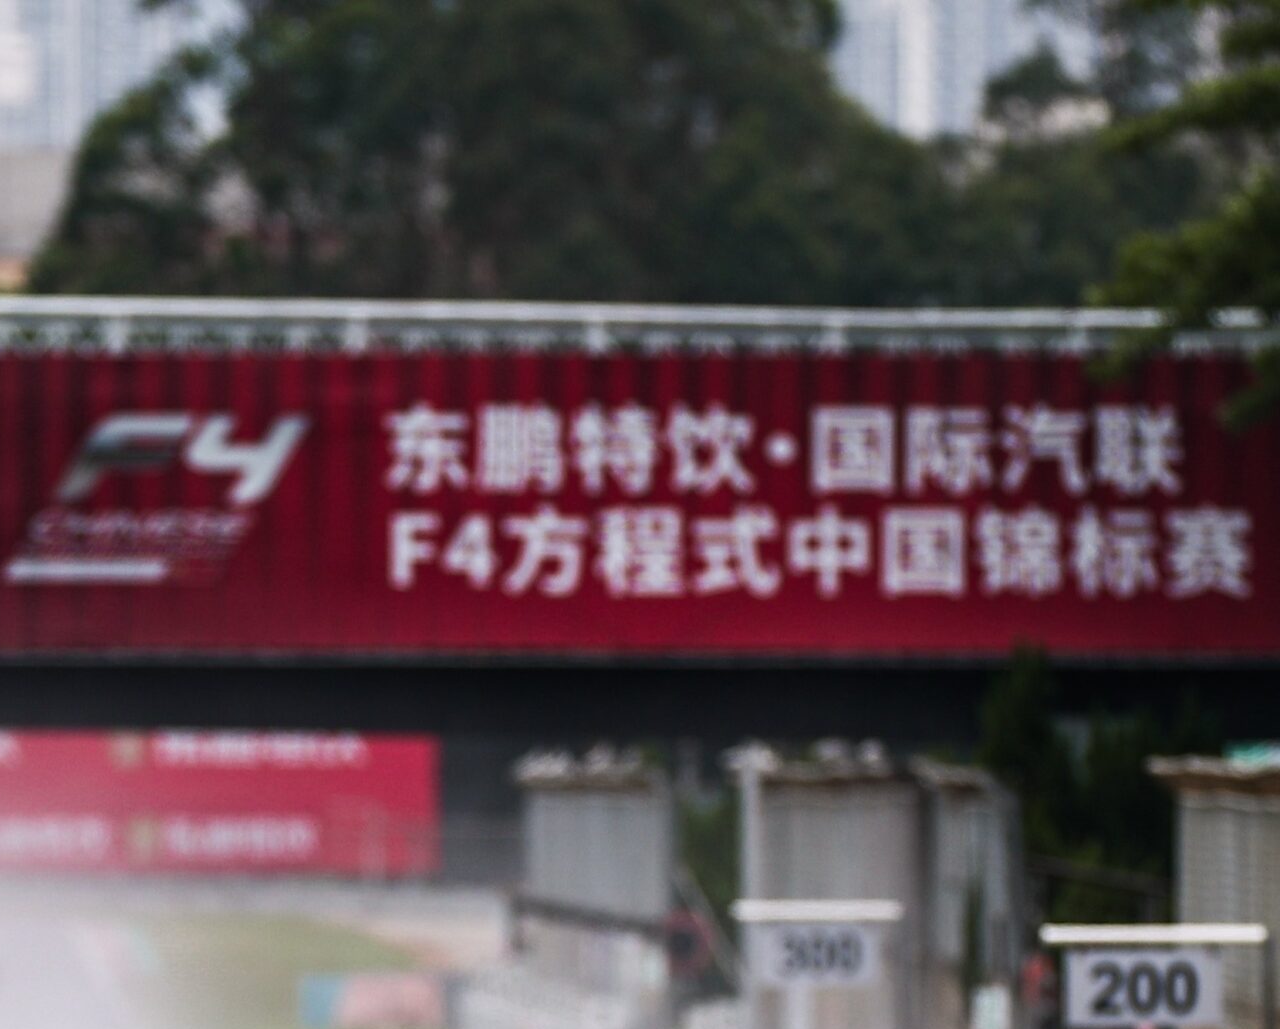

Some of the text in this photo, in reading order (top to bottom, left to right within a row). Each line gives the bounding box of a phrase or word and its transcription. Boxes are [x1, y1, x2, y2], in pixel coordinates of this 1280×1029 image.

[60, 414, 302, 505] F4
[388, 403, 1180, 494] 东鹏特饮·国际汽联
[389, 506, 1252, 598] F4方程式中国锦标赛
[1089, 960, 1200, 1018] 200
